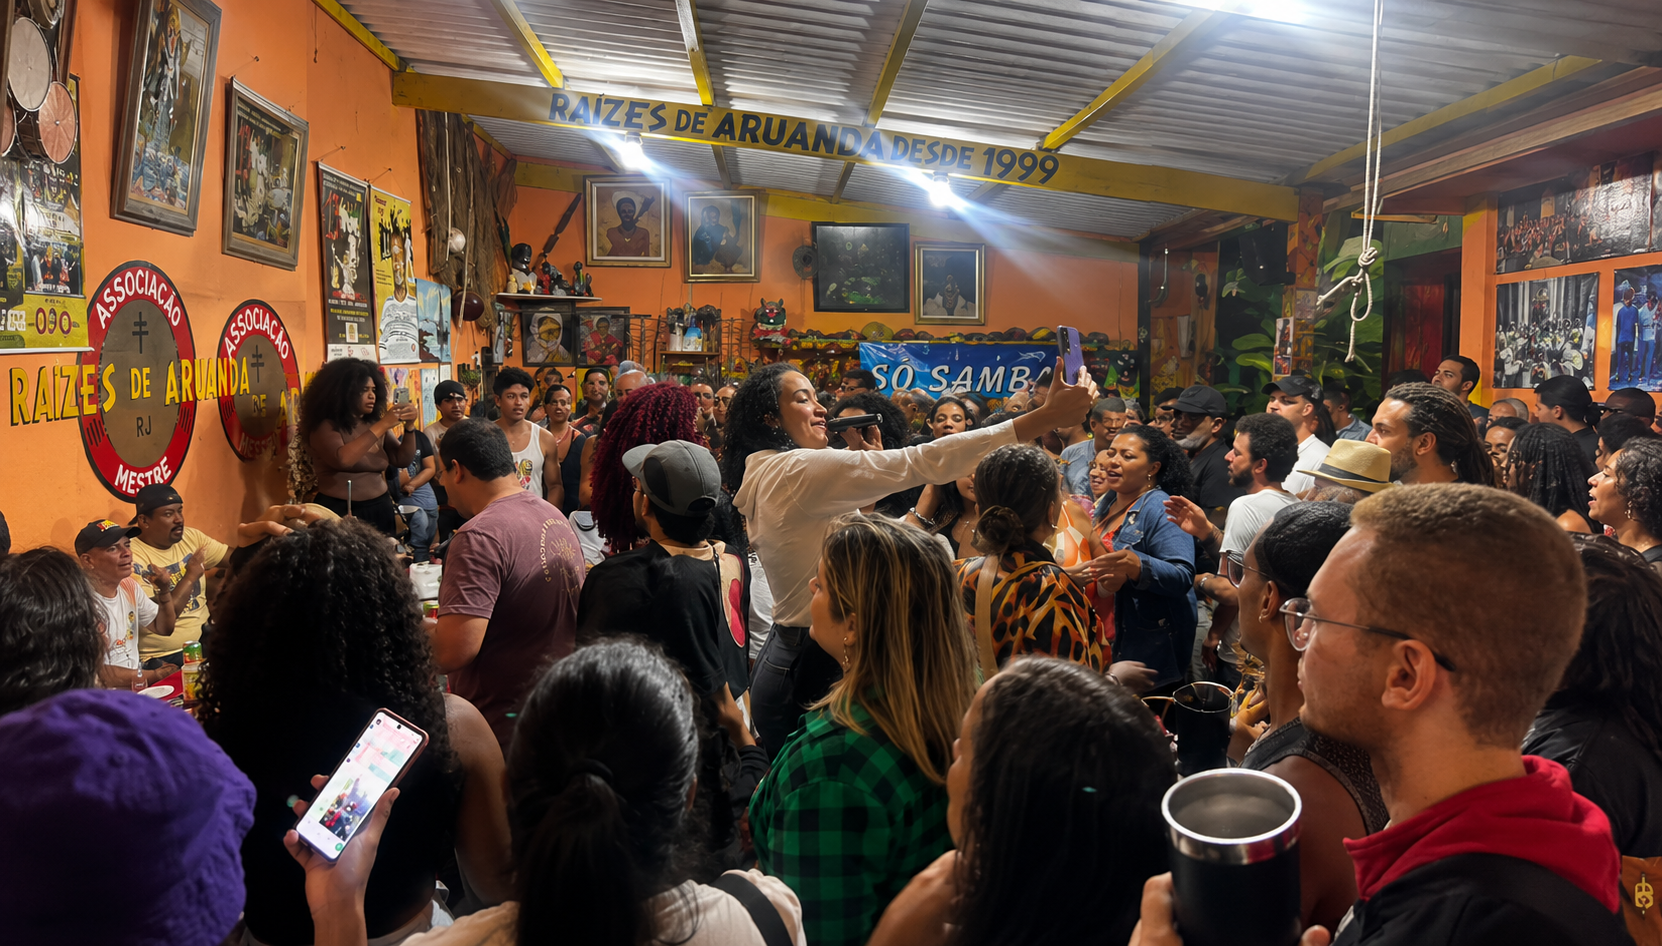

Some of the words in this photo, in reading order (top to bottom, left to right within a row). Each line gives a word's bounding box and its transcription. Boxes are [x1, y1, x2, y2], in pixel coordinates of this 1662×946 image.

[548, 92, 667, 132] RAÍZES
[674, 109, 708, 134] DE
[711, 112, 885, 161] ARUANDA
[890, 135, 975, 171] DESDE
[983, 147, 1060, 185] 1999
[95, 269, 182, 330] ASSOCIAÇÃO
[224, 307, 290, 360] ASSOCIAÇÃO
[9, 360, 117, 427] RAÍZES
[129, 367, 151, 400] DE
[164, 356, 250, 406] ARUANDA
[871, 357, 915, 392] SÓ
[136, 416, 152, 438] RJ
[114, 456, 172, 495] MESTRE
